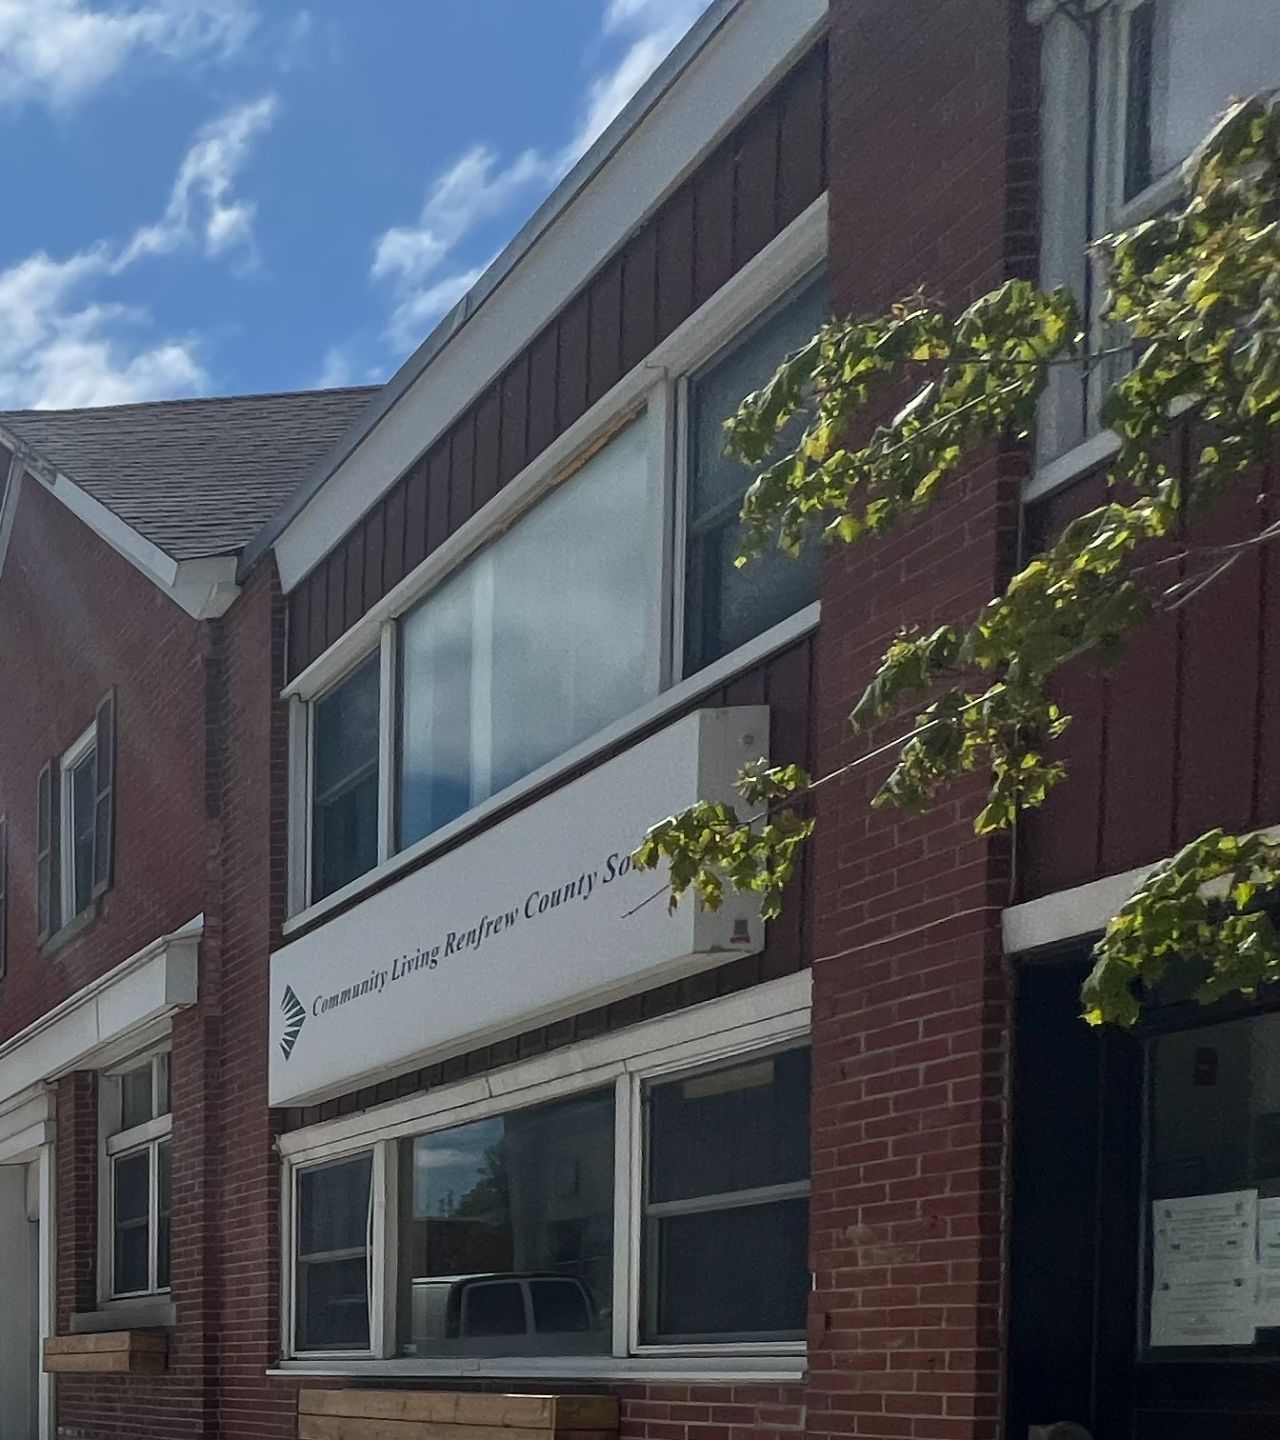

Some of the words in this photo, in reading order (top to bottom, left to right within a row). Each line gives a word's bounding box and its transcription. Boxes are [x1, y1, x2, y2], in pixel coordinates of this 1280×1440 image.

[312, 970, 388, 1017] Community
[391, 947, 439, 983] Living
[444, 908, 518, 957] Renfrew
[524, 872, 597, 919] County
